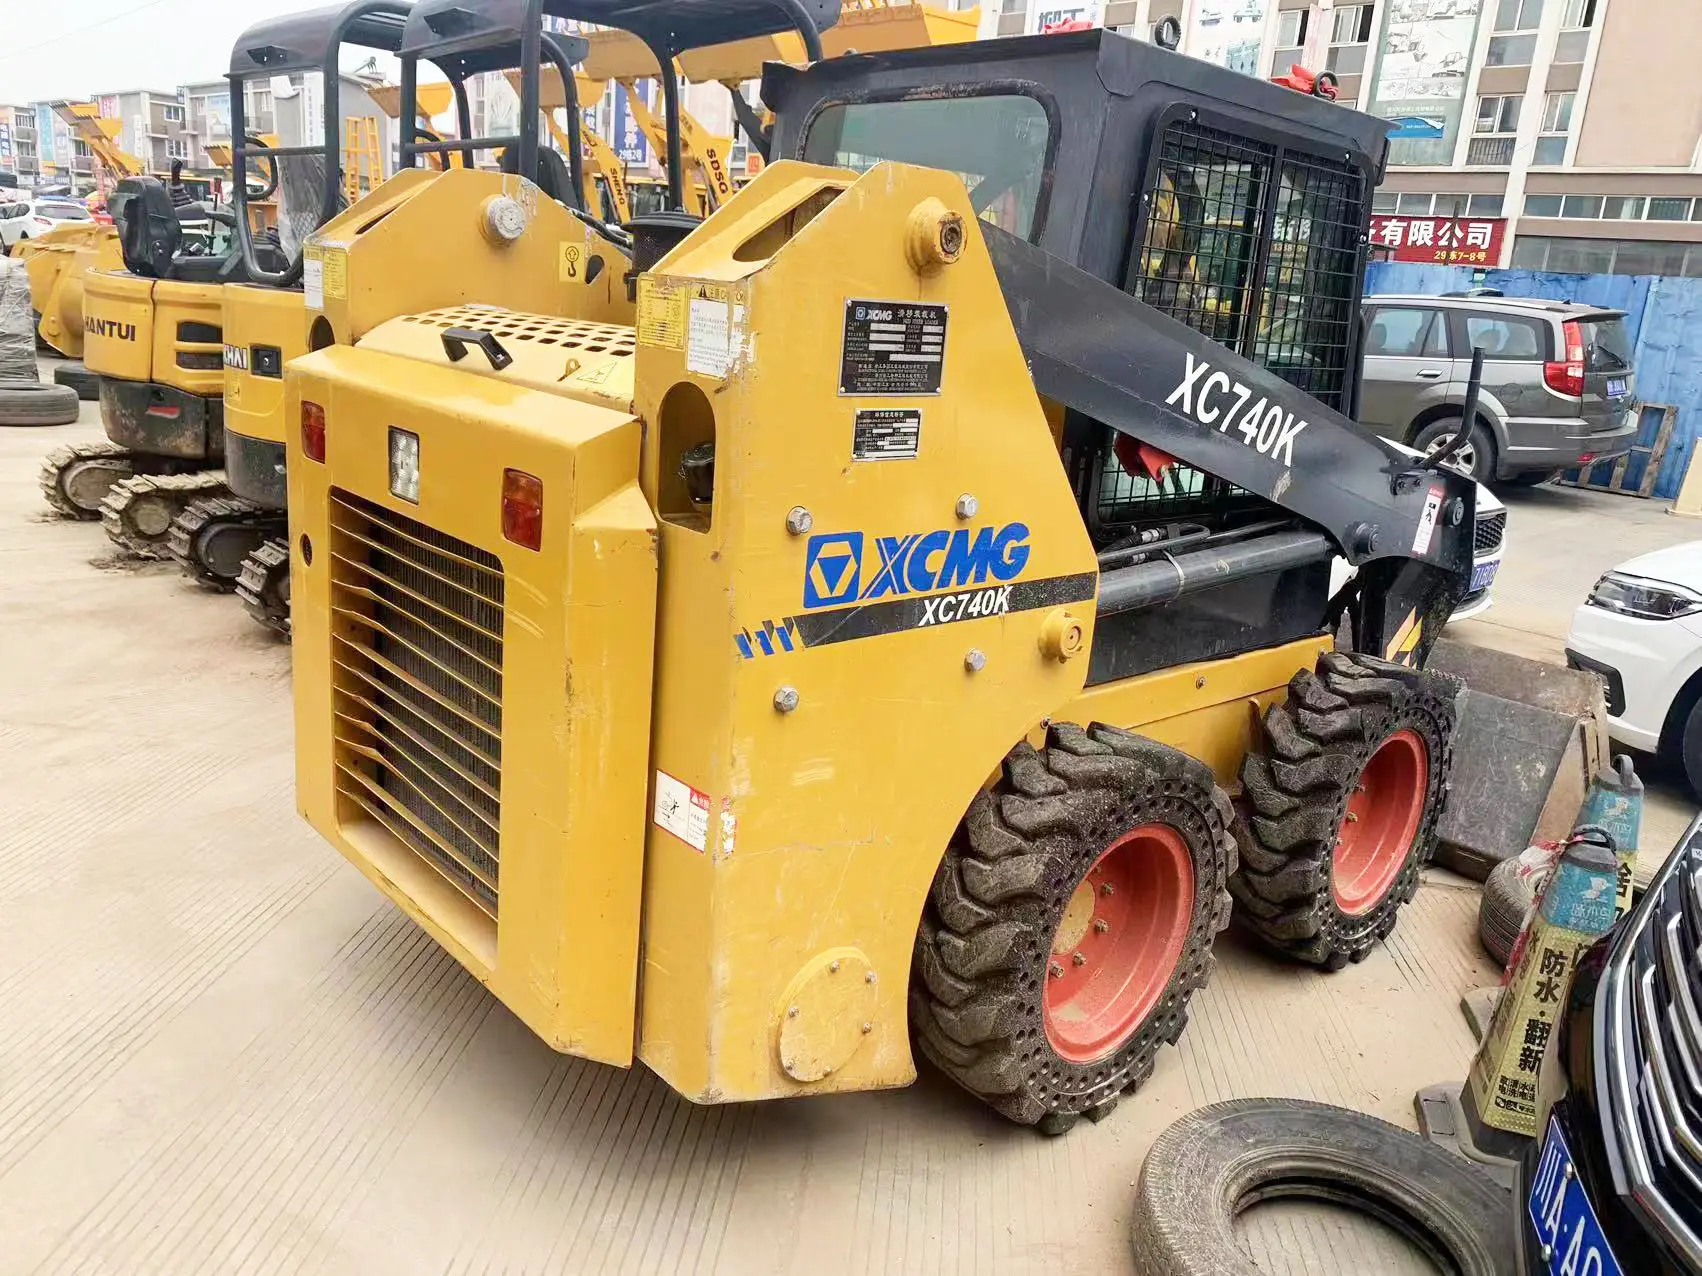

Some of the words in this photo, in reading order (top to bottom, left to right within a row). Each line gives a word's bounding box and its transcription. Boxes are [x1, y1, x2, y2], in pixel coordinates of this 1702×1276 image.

[866, 308, 893, 321] XCMG
[1164, 351, 1309, 468] XC740K
[857, 522, 1031, 599] XCMG
[918, 584, 1014, 627] XC740K
